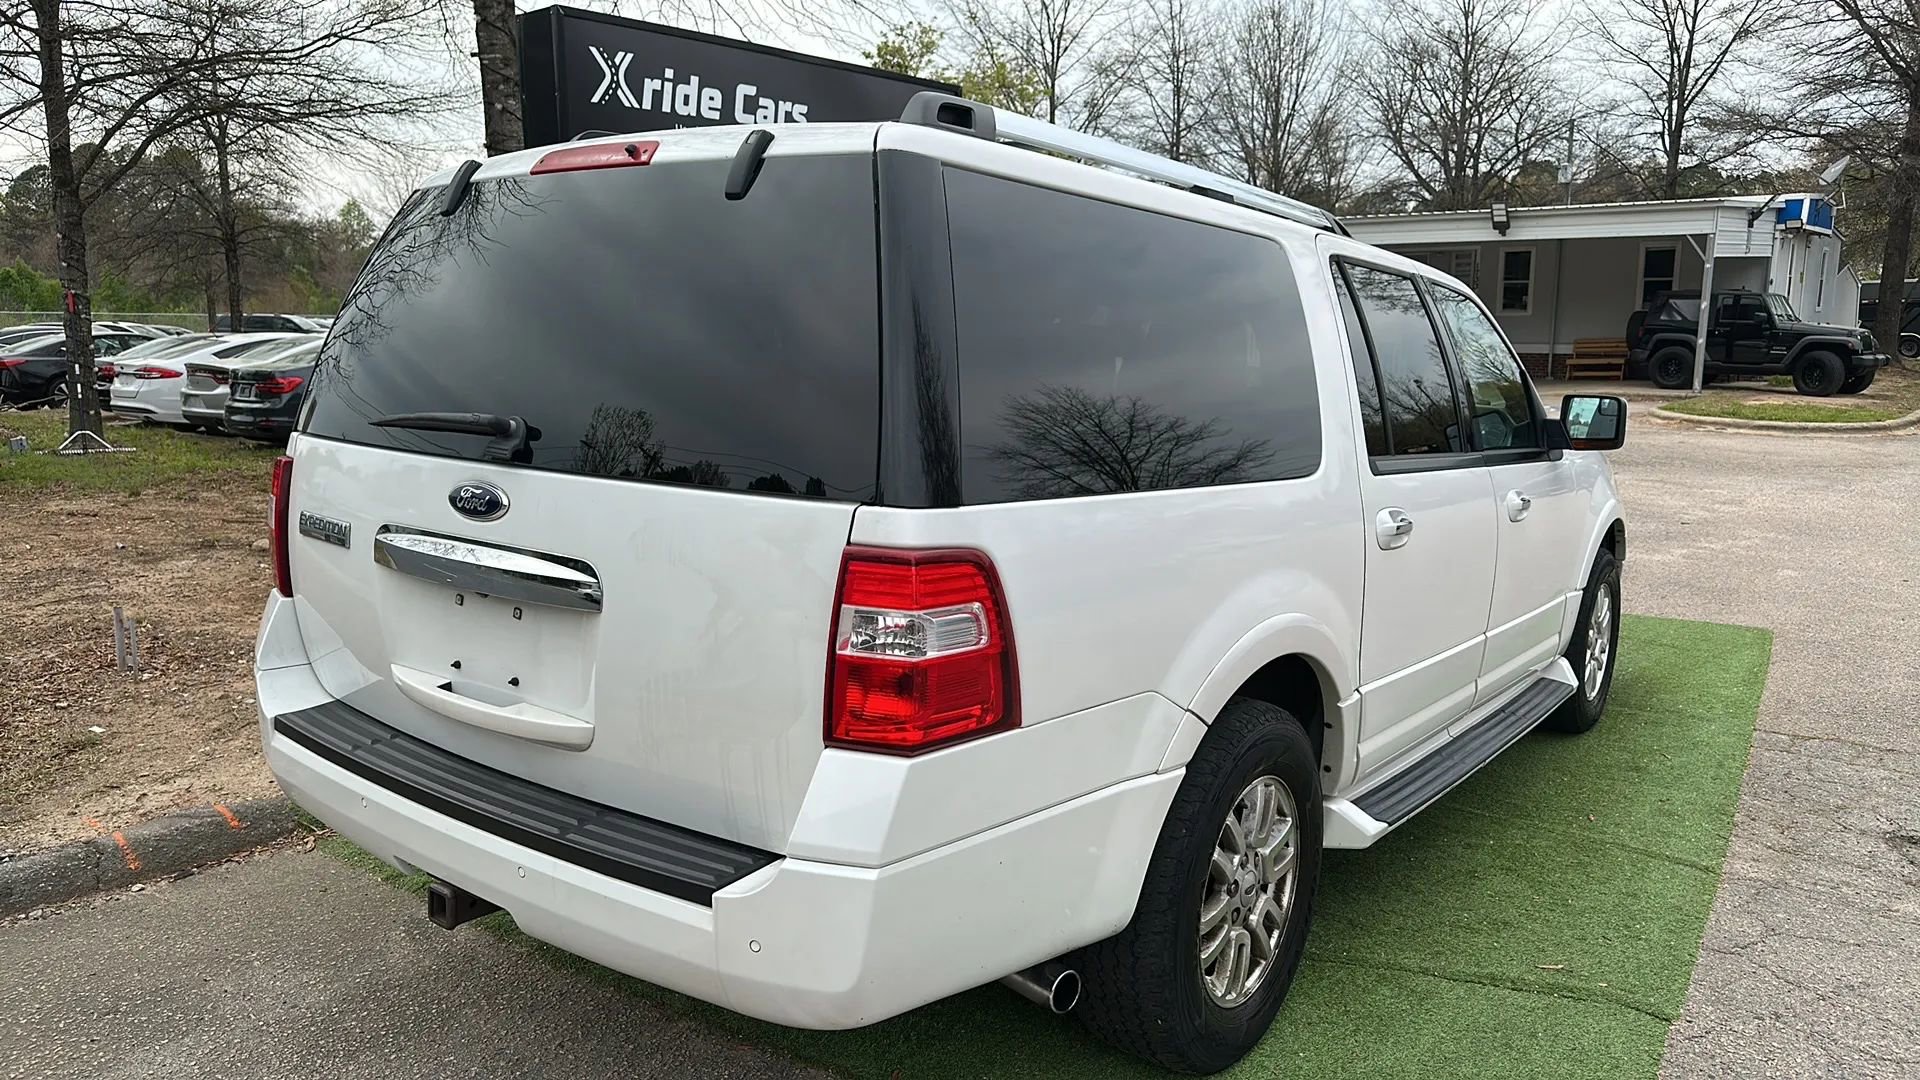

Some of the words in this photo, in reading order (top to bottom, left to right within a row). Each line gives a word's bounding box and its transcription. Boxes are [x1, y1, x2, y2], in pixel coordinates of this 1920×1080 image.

[734, 84, 809, 124] Cars
[456, 486, 490, 511] Ford
[300, 512, 348, 537] EXPEDITION
